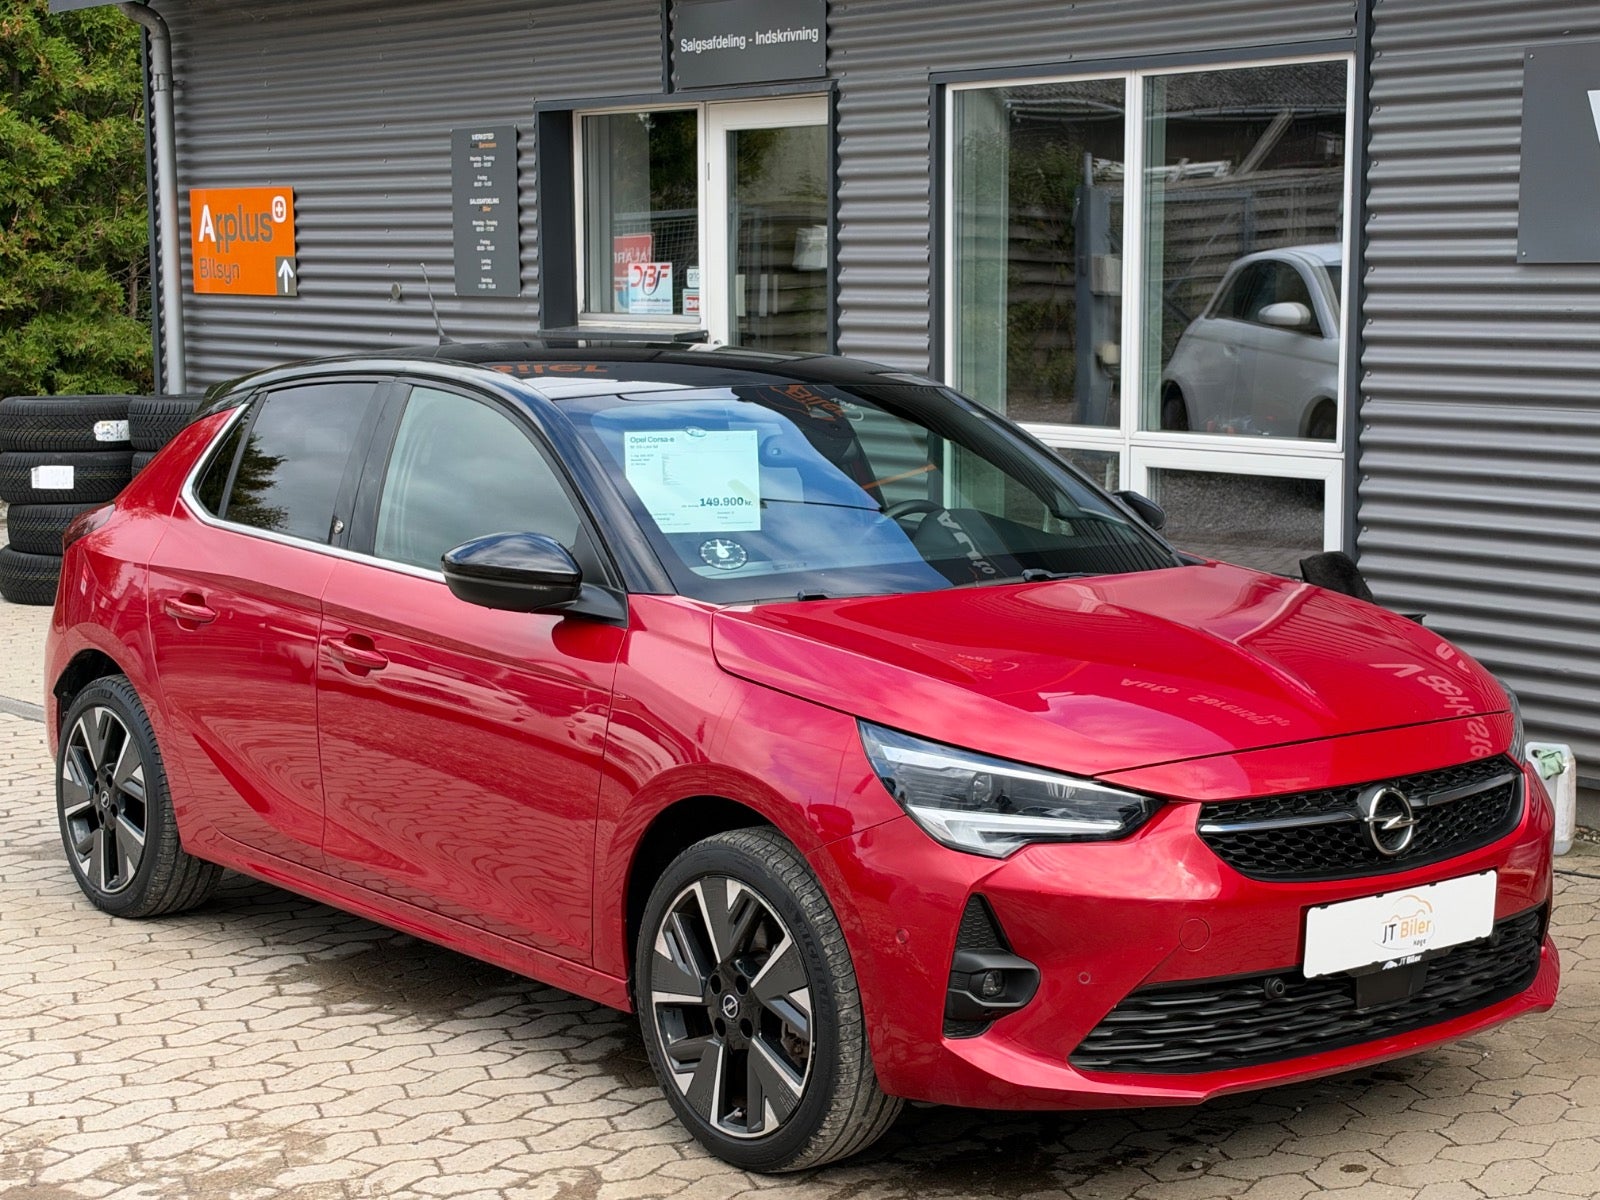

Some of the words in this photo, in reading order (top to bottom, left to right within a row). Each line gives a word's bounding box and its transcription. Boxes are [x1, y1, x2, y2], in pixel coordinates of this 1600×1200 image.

[680, 34, 746, 53] Salgsafdeling
[755, 26, 819, 45] Indskrivning
[199, 257, 240, 285] Bilsyn
[629, 436, 647, 444] Opel
[699, 496, 744, 507] 149.900
[1382, 923, 1397, 944] JT
[1400, 918, 1432, 938] Biler
